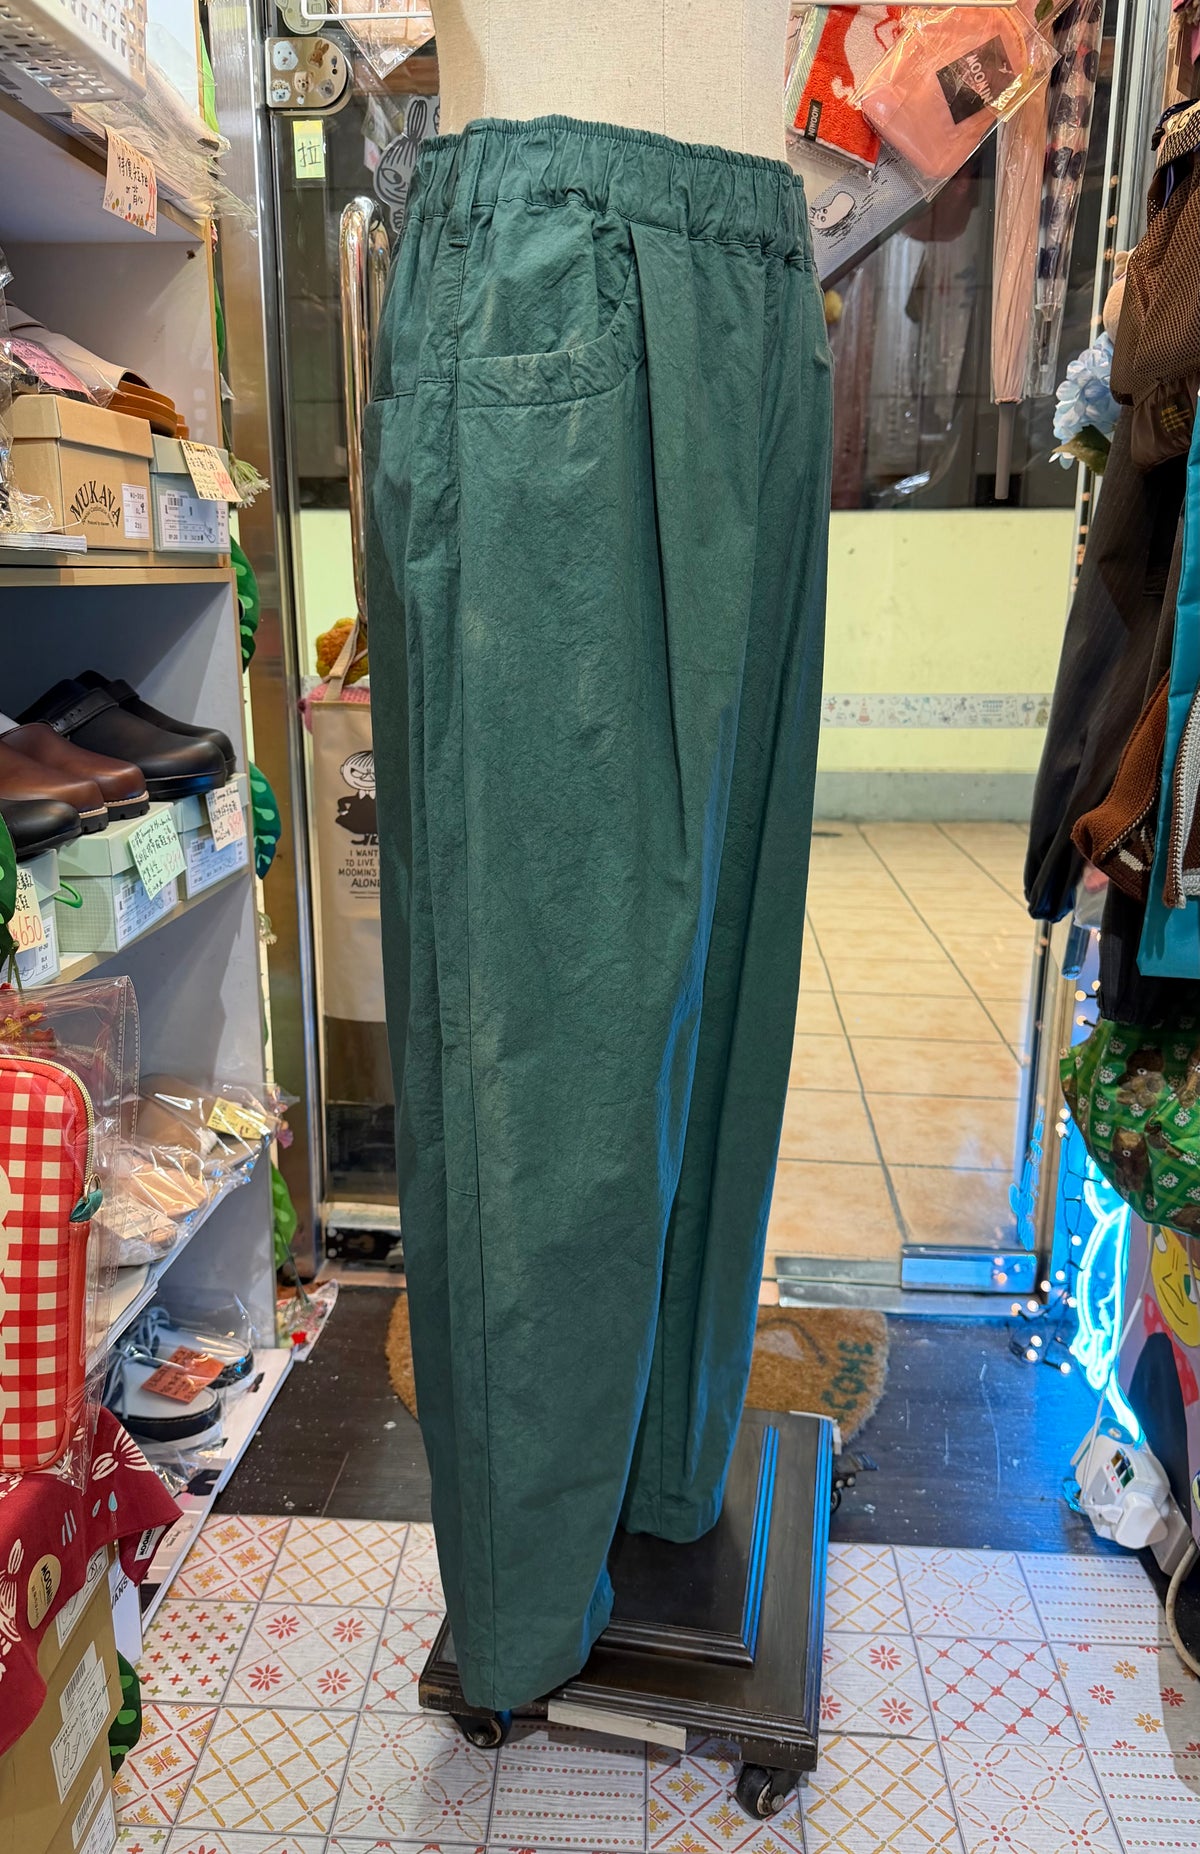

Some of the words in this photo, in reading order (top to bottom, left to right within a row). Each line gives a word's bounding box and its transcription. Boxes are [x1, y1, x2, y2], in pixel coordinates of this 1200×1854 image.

[966, 54, 993, 104] MOOMIN
[807, 105, 820, 137] MOOMIN
[297, 140, 321, 167] 拉
[70, 480, 121, 528] MUKAVA
[345, 858, 355, 867] TO
[357, 858, 375, 867] LIVE
